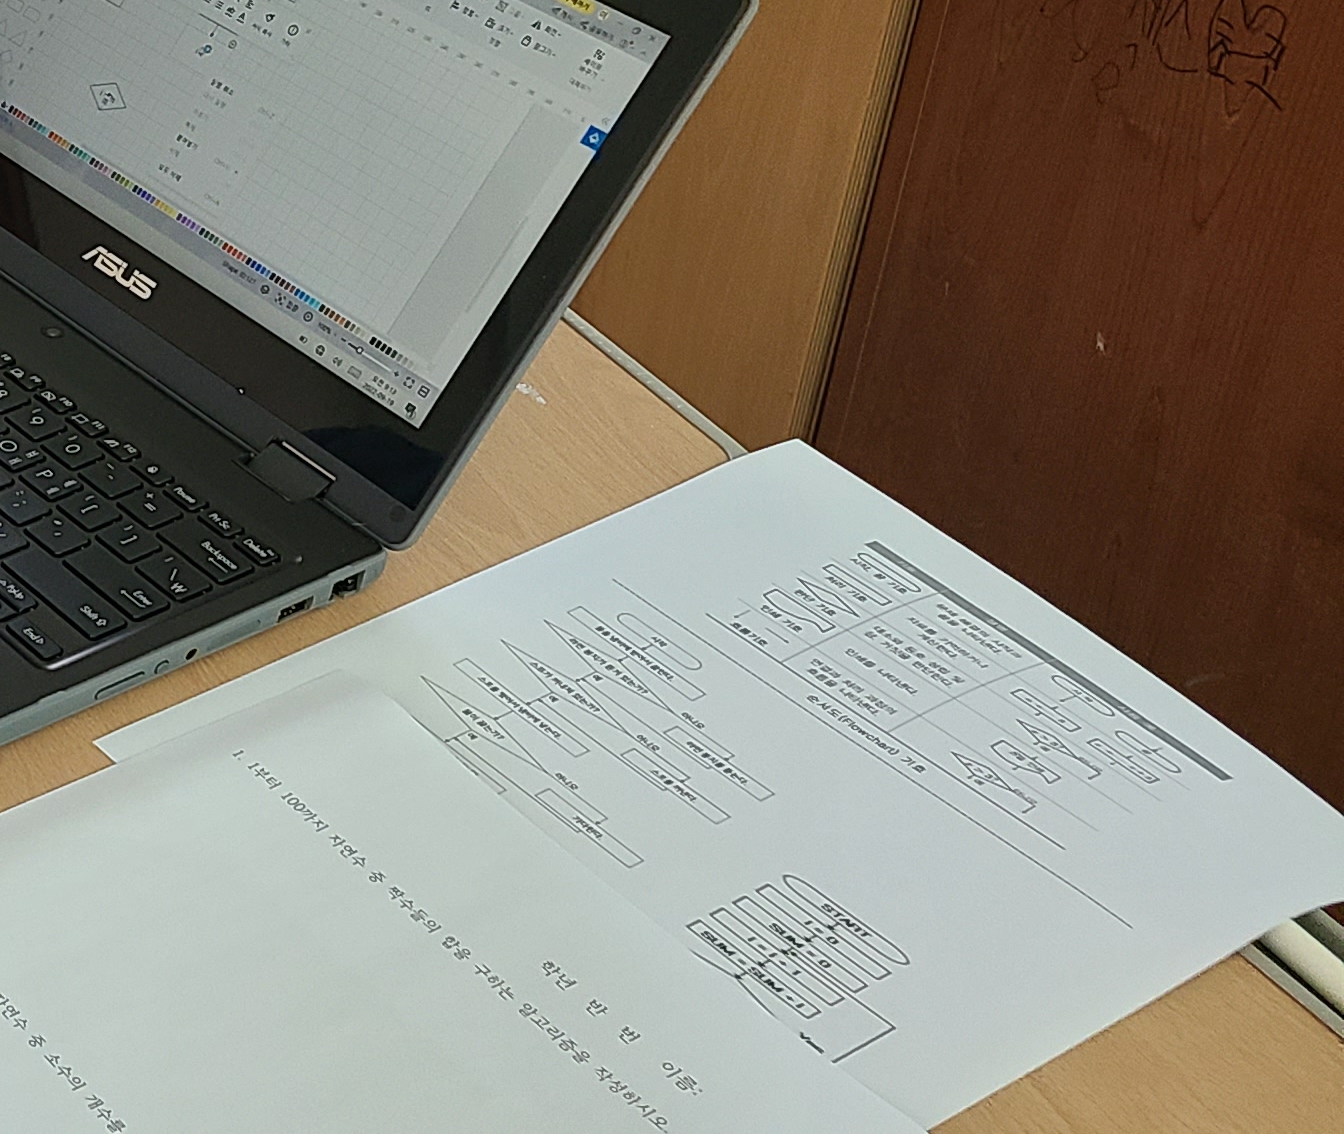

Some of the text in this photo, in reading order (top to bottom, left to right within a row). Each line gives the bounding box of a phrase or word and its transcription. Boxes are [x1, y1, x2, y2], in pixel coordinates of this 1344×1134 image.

[81, 246, 158, 300] ASUS
[29, 416, 45, 425] 9
[0, 440, 18, 453] O
[65, 444, 81, 454] 0
[35, 469, 54, 479] P
[200, 540, 238, 570] Backspace
[79, 605, 100, 622] Shift
[901, 756, 926, 773] 기호
[820, 903, 874, 939] START
[247, 761, 282, 791] 1부터
[281, 791, 329, 833] 100까지
[328, 833, 367, 868] 자연수
[368, 870, 387, 884] 중
[388, 884, 442, 934] 짝수들의
[441, 935, 472, 961] 합을
[474, 962, 515, 1001] 구하는
[518, 1002, 591, 1065] 알고리즘을
[594, 1065, 669, 1134] 작성하시오.
[769, 922, 805, 950] SUM
[700, 930, 784, 993] SUM SUM
[541, 959, 577, 991] 학년
[585, 997, 609, 1018] 반
[617, 1025, 642, 1045] 번
[28, 1034, 47, 1048] 중
[44, 1053, 87, 1092] 소수의
[84, 1093, 127, 1133] 개수를
